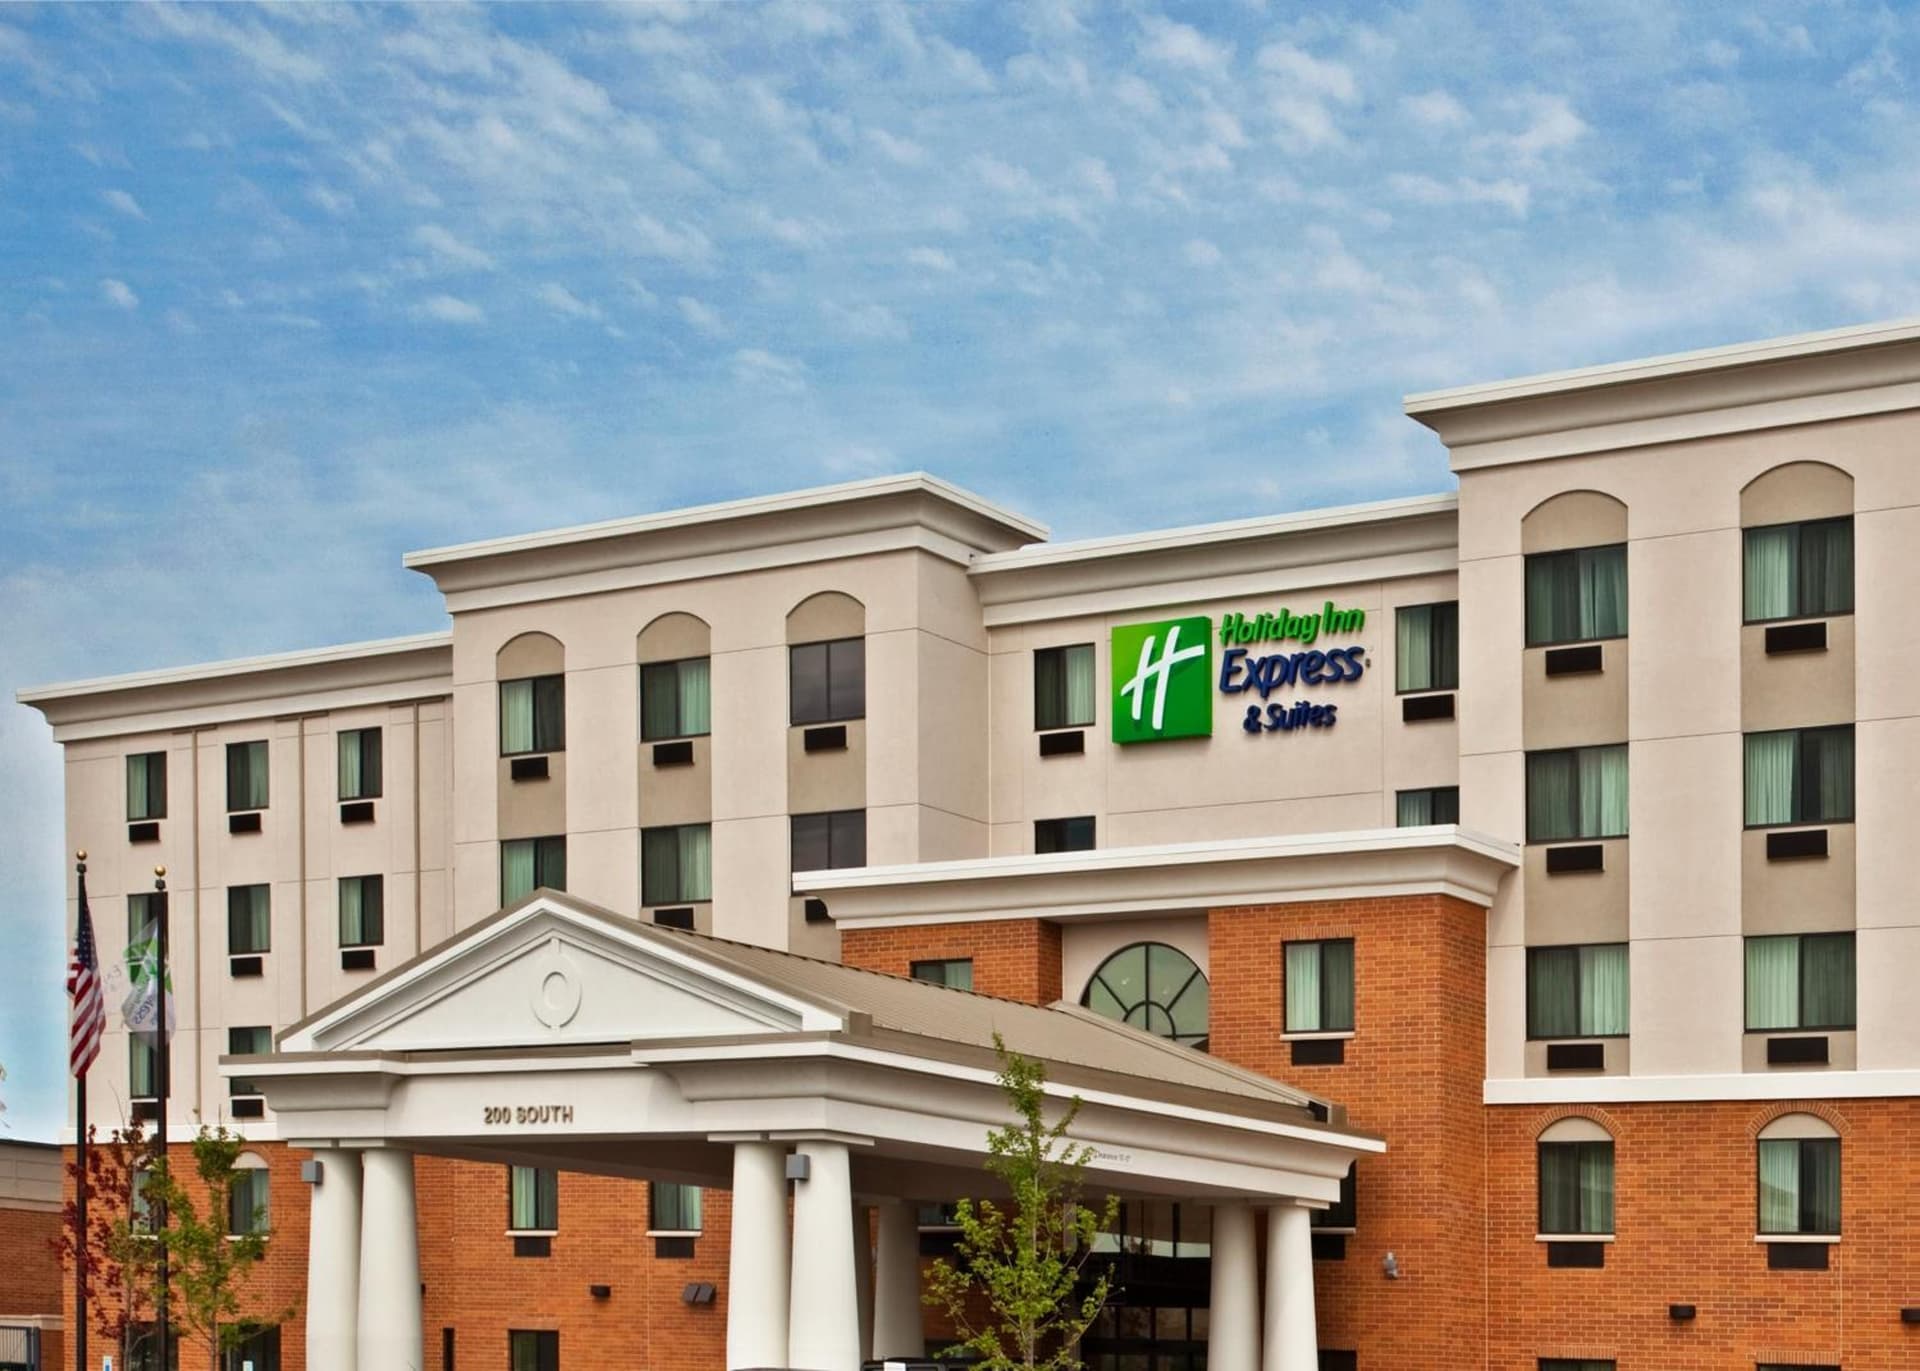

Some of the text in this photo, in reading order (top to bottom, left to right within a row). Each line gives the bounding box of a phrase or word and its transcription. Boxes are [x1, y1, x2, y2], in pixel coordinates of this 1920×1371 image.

[1219, 601, 1365, 645] Holiday Inn
[1219, 646, 1365, 699] Express
[1243, 700, 1337, 733] & Suites
[484, 1105, 573, 1124] 200 SOUTH
